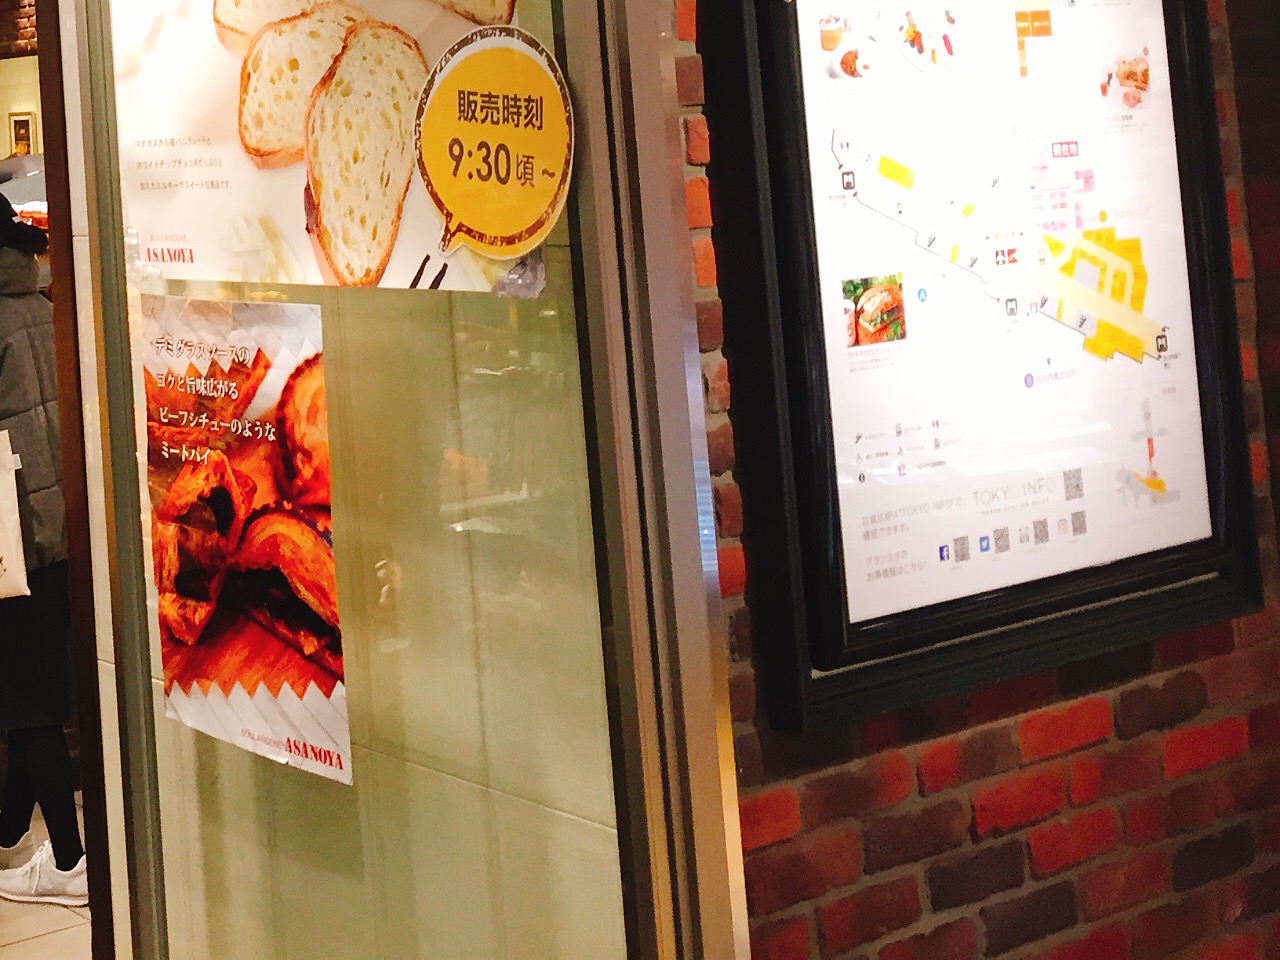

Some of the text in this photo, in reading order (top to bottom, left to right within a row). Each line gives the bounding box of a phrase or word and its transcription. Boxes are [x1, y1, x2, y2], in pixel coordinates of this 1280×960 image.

[458, 90, 543, 131] 販売時刻
[145, 247, 195, 263] ASANOYA
[155, 337, 251, 364] デミグラスソースの
[156, 373, 239, 400] コクと旨味広がる
[159, 407, 276, 441] ビーフシチューのような
[161, 441, 211, 465] ミートパイ
[1023, 476, 1057, 497] INFO
[285, 737, 343, 770] ASANOYA
